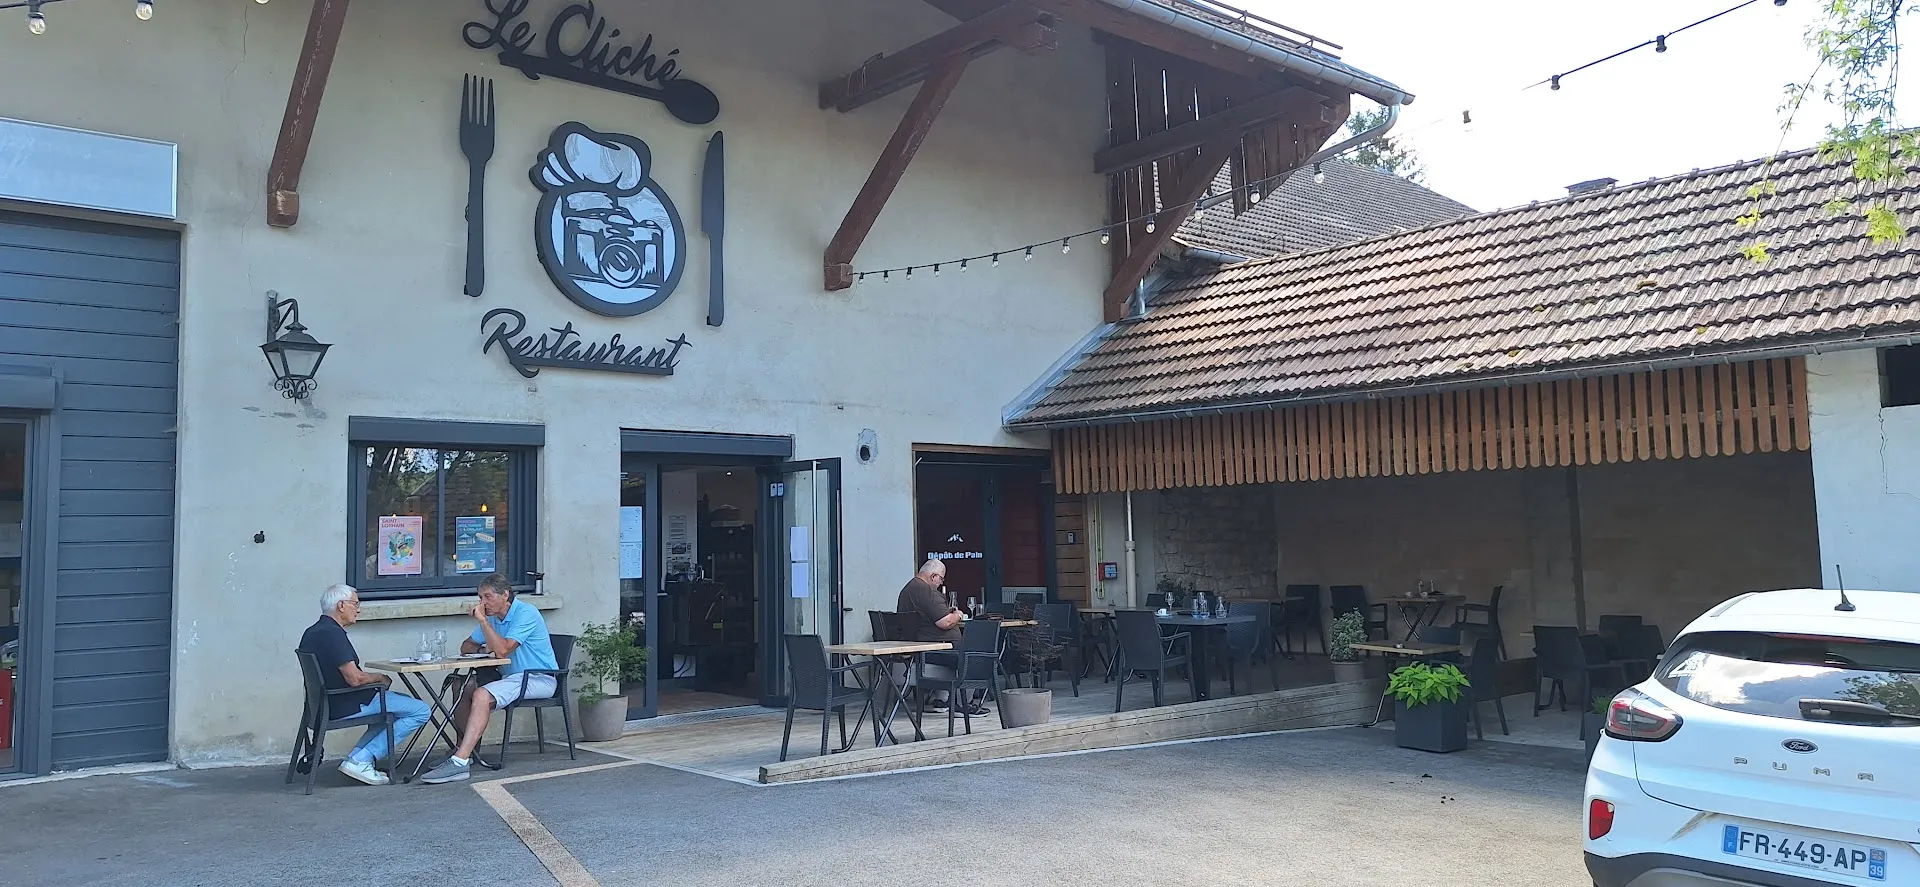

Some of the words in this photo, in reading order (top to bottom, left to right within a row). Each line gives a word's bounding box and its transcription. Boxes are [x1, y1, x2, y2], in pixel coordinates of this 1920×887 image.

[463, 0, 540, 80] Le
[546, 0, 682, 83] Cliché
[481, 308, 693, 379] Restaurant
[927, 551, 953, 560] Dépôt
[954, 551, 965, 559] de
[965, 551, 983, 559] Pain
[1789, 741, 1809, 751] Ford
[1734, 756, 1874, 782] PUMA
[1739, 831, 1867, 871] FR-449-AP
[1869, 864, 1884, 877] 39
